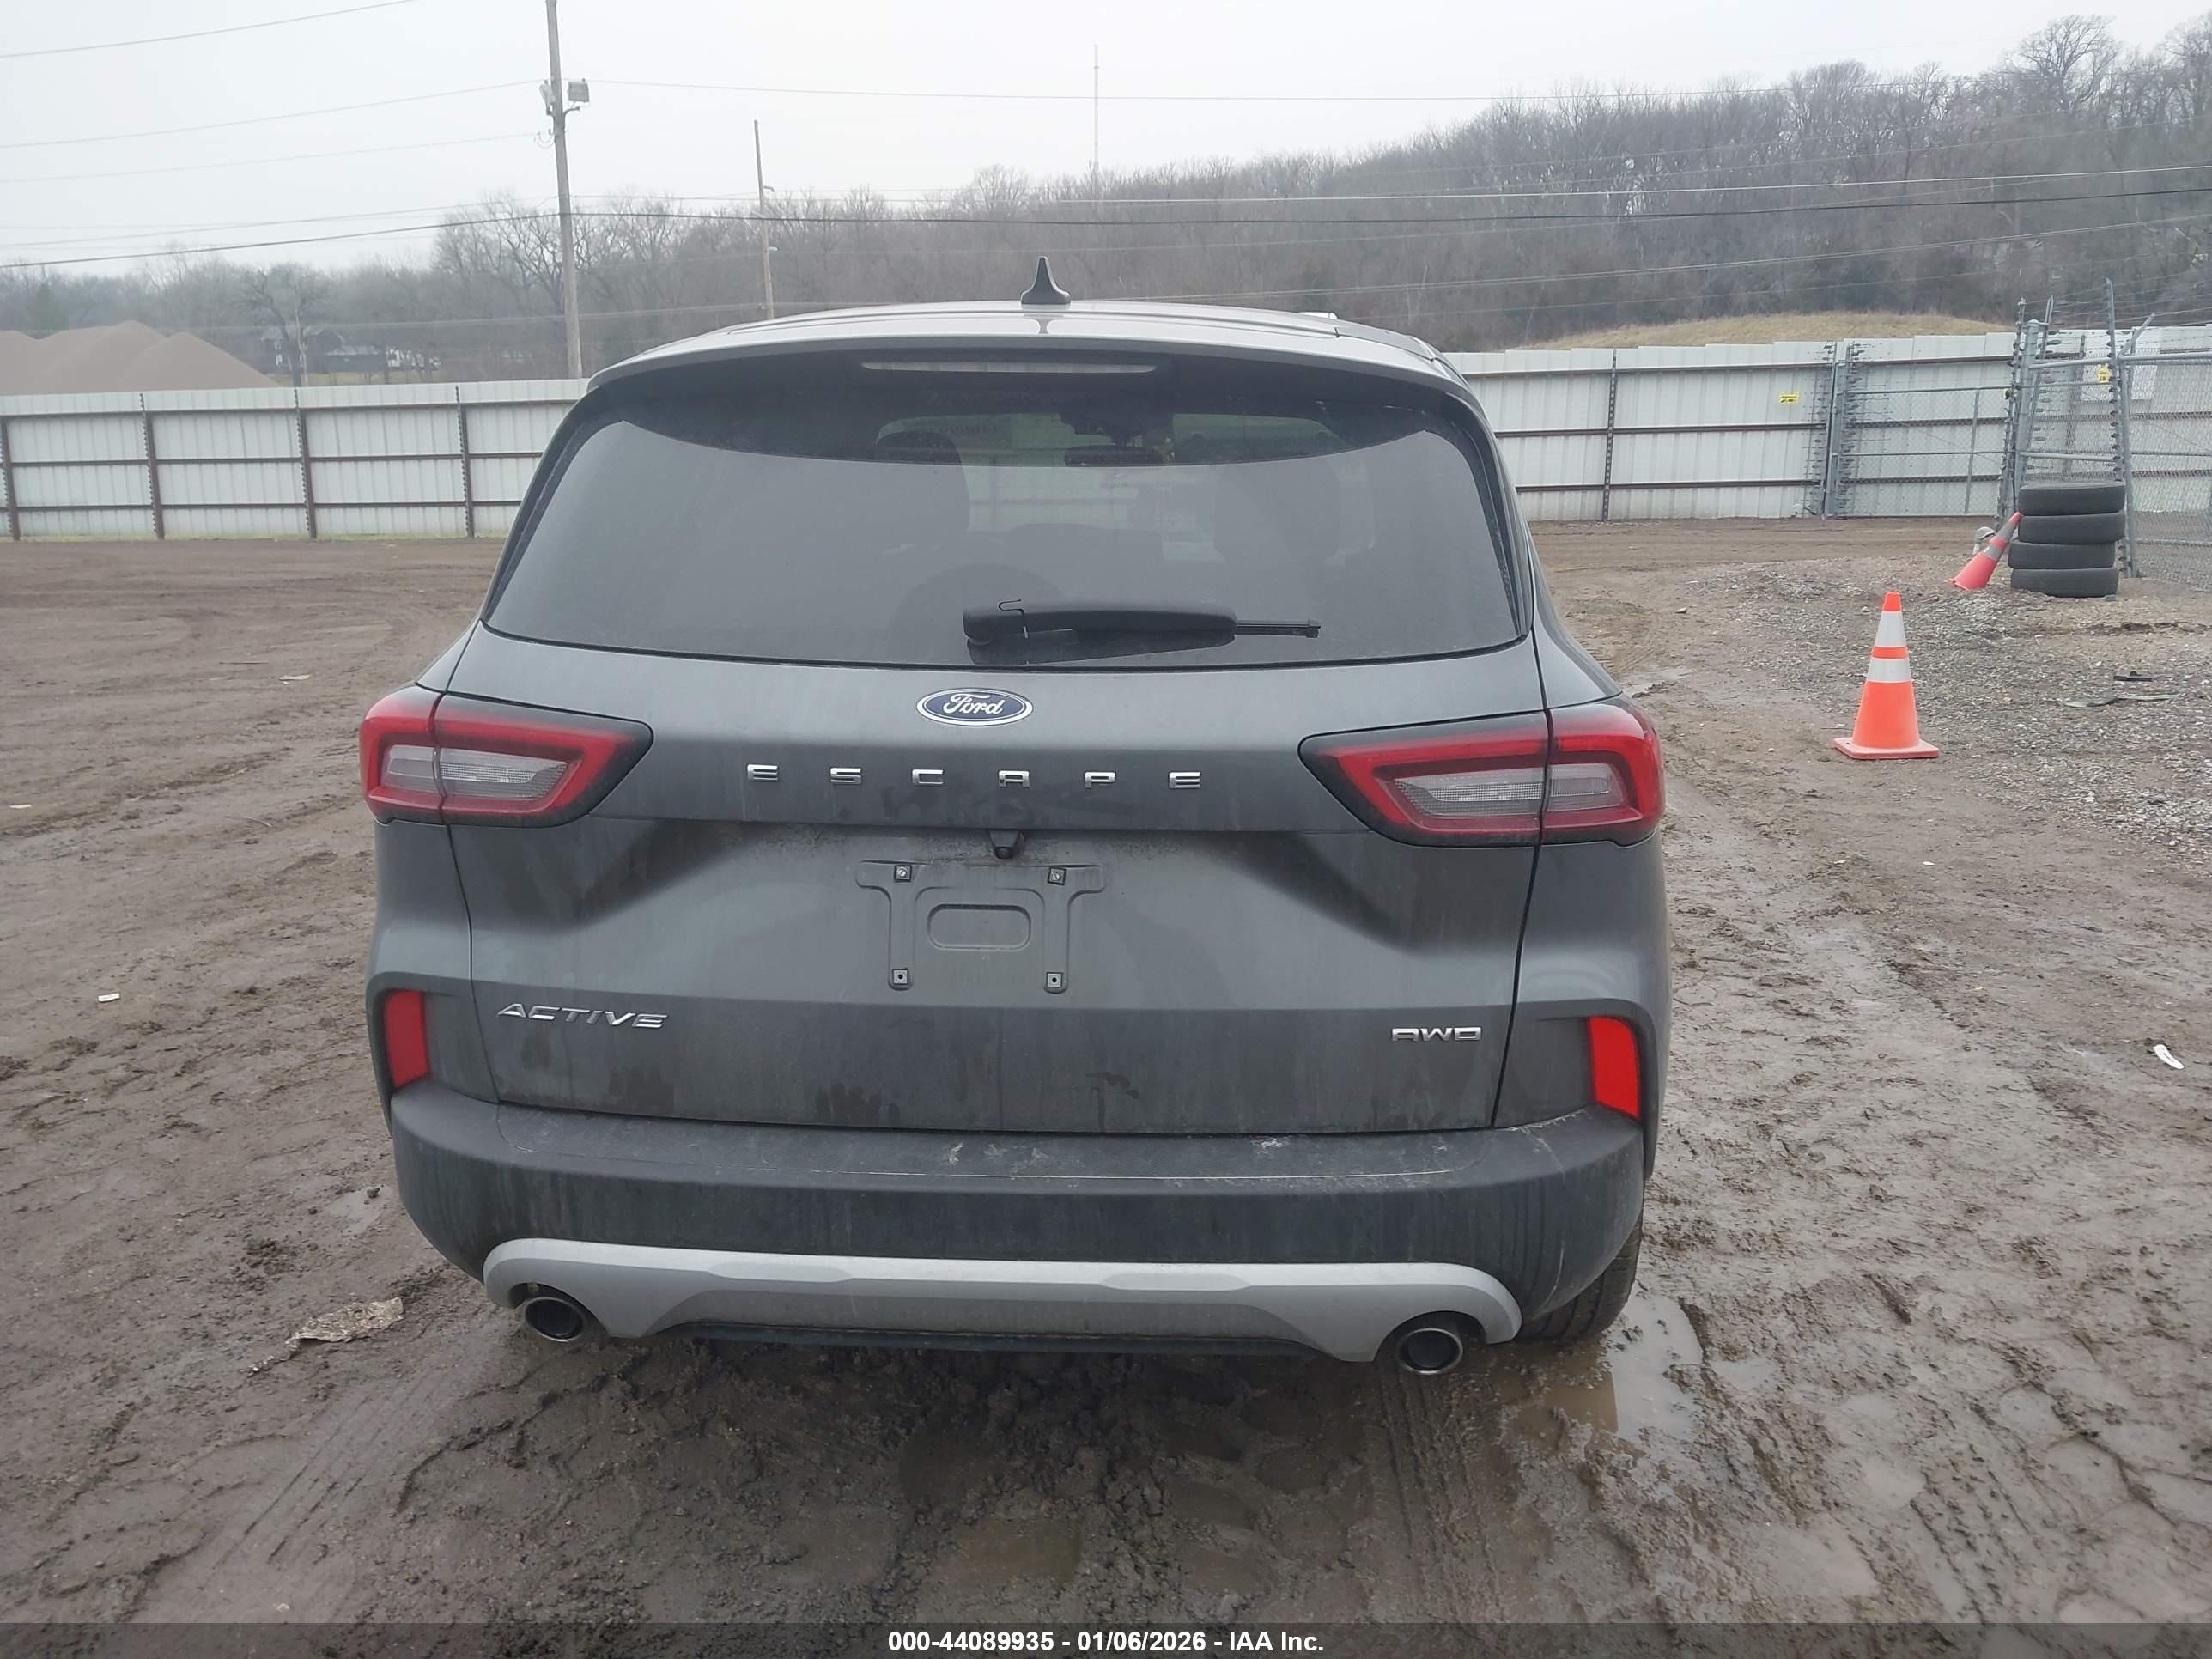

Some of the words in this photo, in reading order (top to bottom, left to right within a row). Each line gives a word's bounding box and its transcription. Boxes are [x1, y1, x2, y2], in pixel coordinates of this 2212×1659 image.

[943, 693, 1006, 714] Ford
[747, 763, 1201, 788] ESCAPE
[496, 1003, 668, 1029] ACTIVE
[1392, 1026, 1481, 1042] AWD
